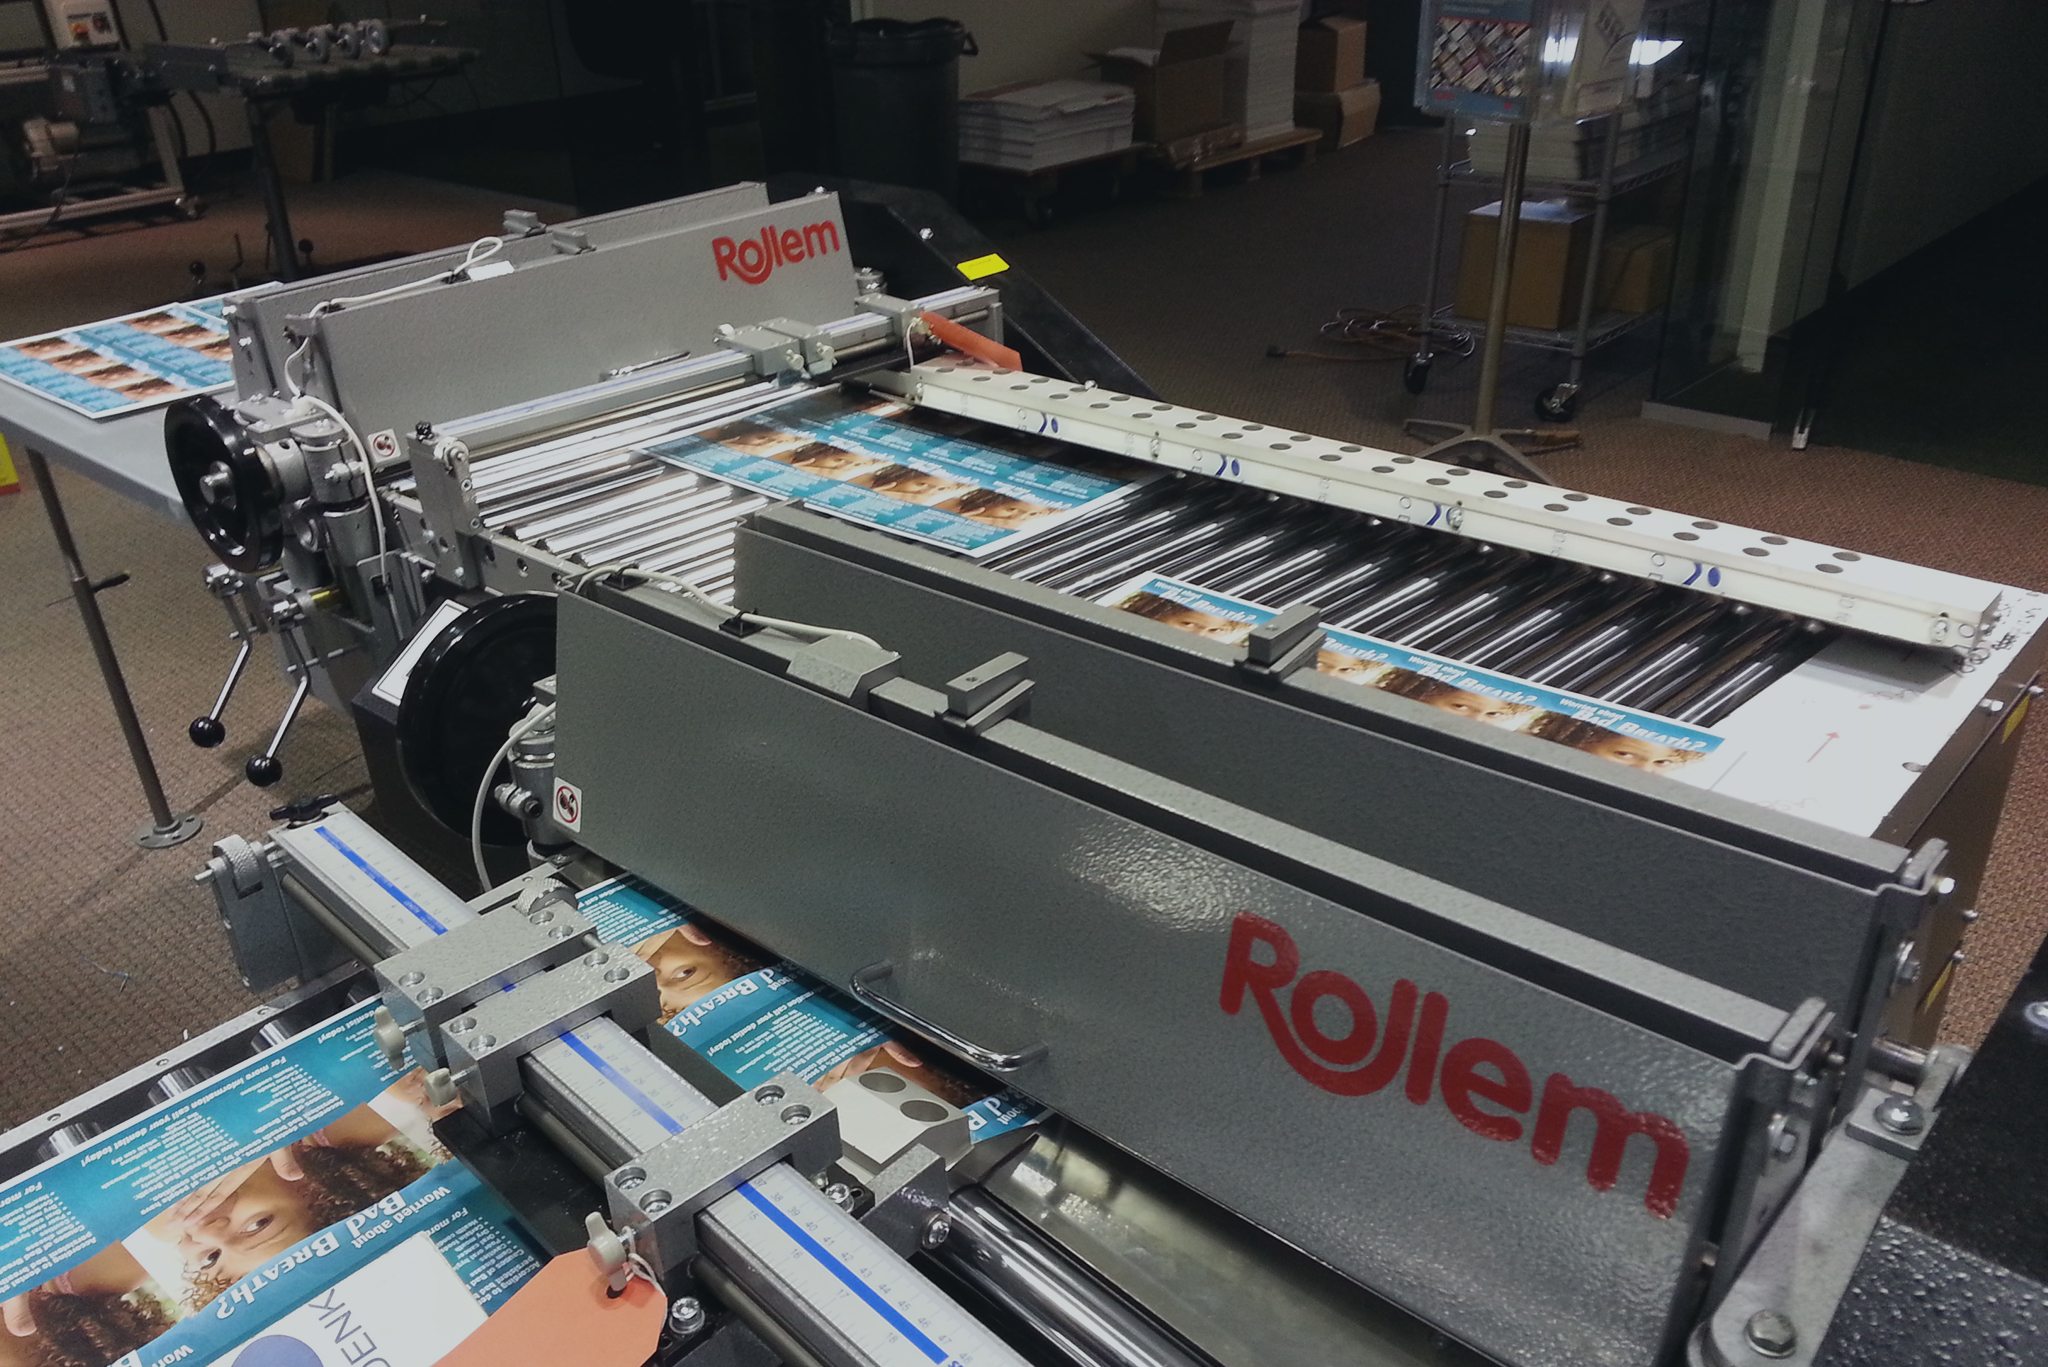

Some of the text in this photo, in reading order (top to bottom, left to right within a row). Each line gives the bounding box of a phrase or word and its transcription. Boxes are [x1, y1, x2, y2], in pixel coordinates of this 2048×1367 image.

[712, 220, 840, 285] Rollem
[1219, 910, 1689, 1219] Rollem
[351, 1186, 451, 1248] Worried about
[449, 1205, 468, 1222] For
